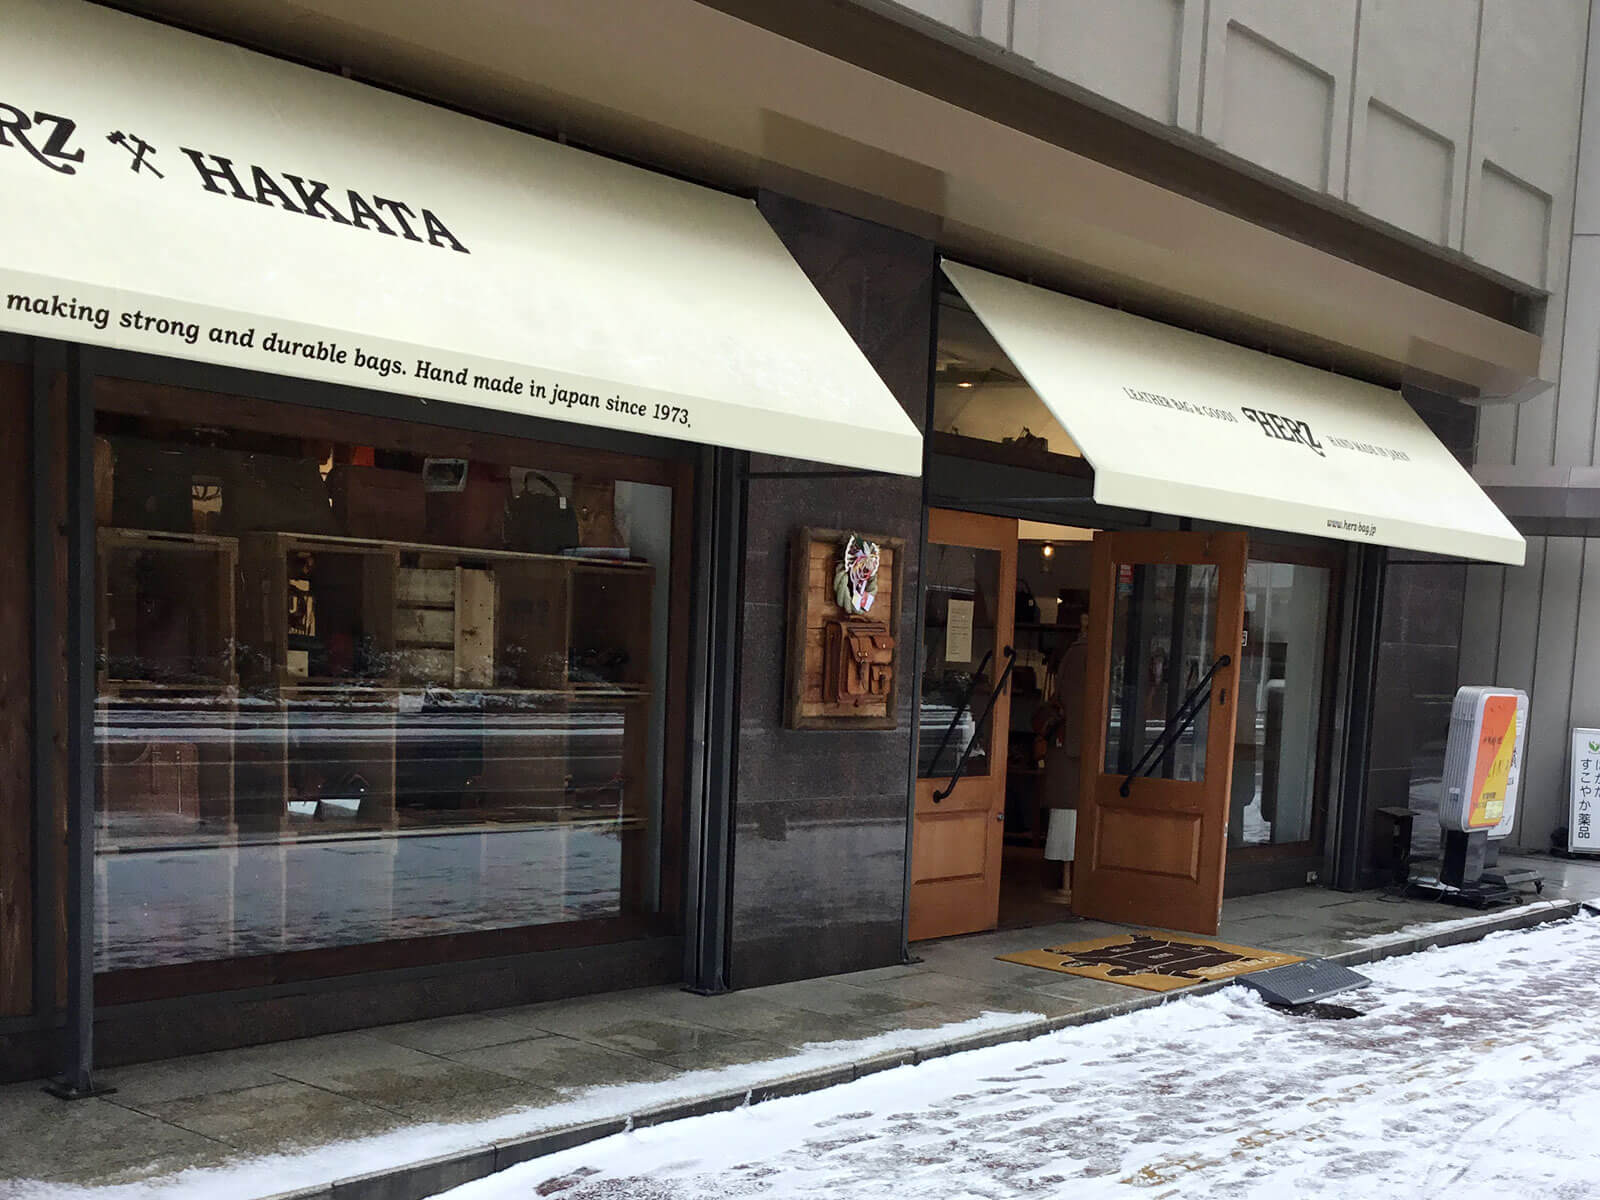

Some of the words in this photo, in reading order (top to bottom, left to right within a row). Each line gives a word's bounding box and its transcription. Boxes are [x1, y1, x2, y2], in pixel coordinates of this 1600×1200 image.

[180, 147, 470, 254] HAKATA
[6, 294, 110, 330] making
[119, 310, 200, 345] strong
[208, 328, 255, 348] and
[262, 332, 348, 364] durable
[353, 348, 407, 377] bags.
[414, 359, 469, 386] Hand
[473, 376, 524, 395] made
[529, 379, 547, 399] in
[548, 383, 600, 409] japan
[605, 395, 647, 417] since
[652, 403, 692, 428] 1973.
[1122, 386, 1174, 409] LEATHER
[1169, 398, 1195, 414] BAG
[1241, 406, 1327, 458] HERZ
[1577, 758, 1593, 839] すこやか薬品
